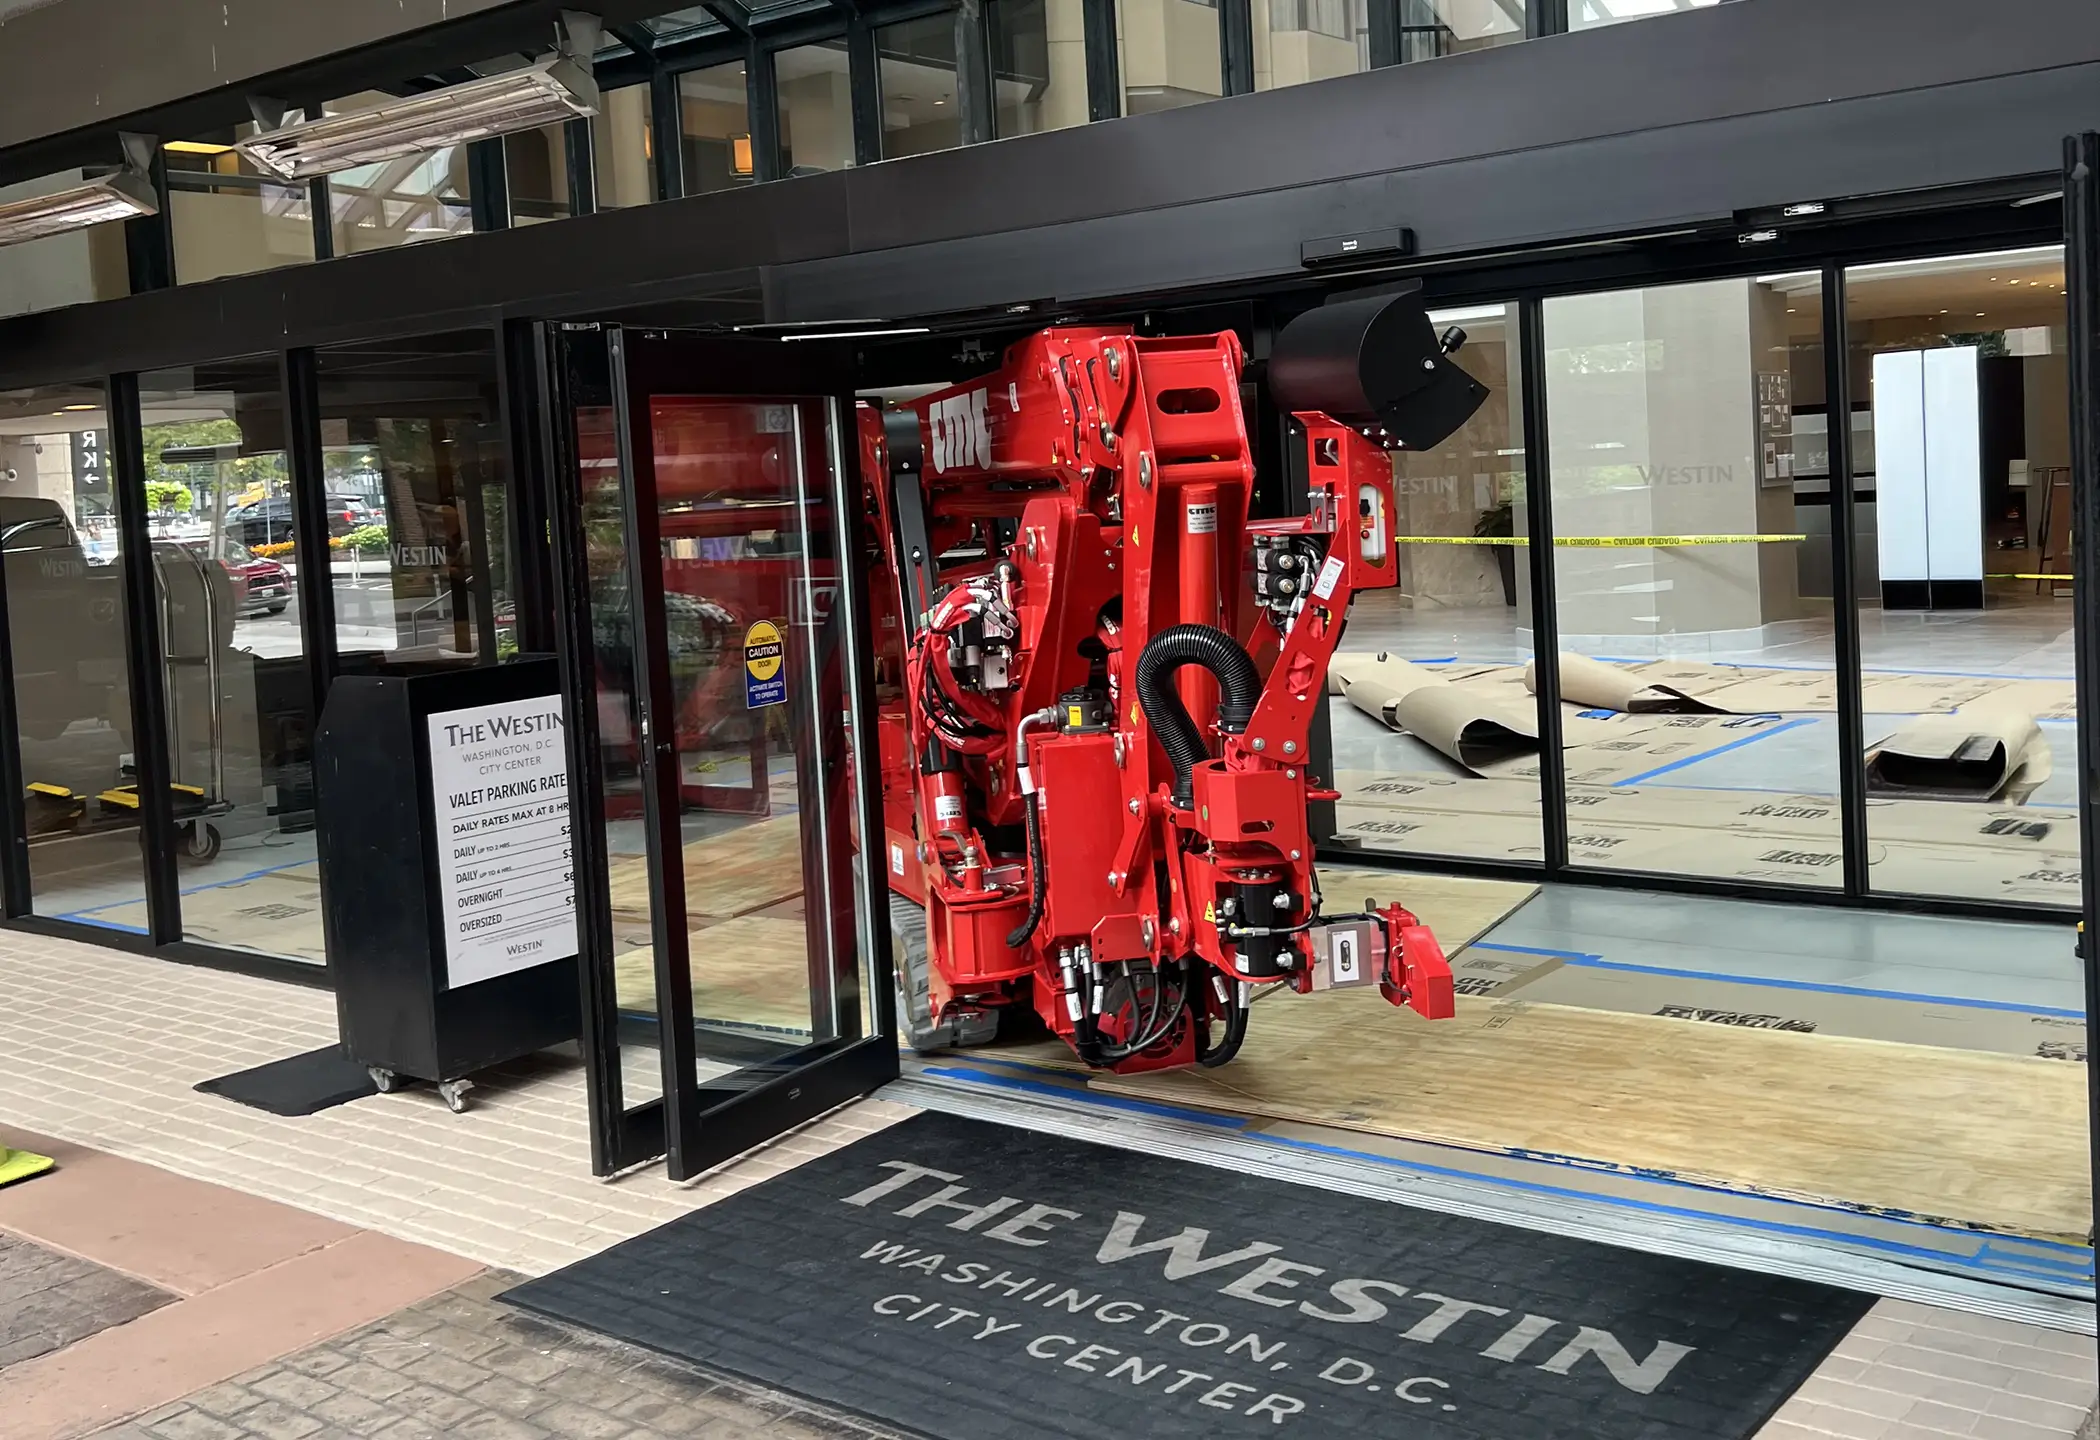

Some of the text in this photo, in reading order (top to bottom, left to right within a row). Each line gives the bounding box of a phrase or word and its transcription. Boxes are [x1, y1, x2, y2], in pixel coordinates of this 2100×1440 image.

[1637, 464, 1732, 486] WESTIN
[385, 542, 447, 567] WESTIN
[38, 557, 83, 579] WESTIN
[750, 635, 776, 645] AUTOMATIC
[748, 644, 779, 658] CAUTION
[758, 660, 772, 668] DOOR
[444, 712, 564, 746] THE WESTIN
[462, 743, 533, 763] WASHINGTON,
[479, 756, 542, 775] CITY CENTER
[449, 789, 484, 809] VALET
[487, 779, 537, 802] PARKING
[453, 820, 479, 834] DAILY
[482, 814, 510, 828] RATES
[512, 809, 534, 822] MAX
[535, 805, 547, 817] AT
[549, 804, 554, 814] 8
[454, 845, 476, 859] DAILY
[456, 869, 478, 884] DAILY
[458, 888, 503, 908] OVERNIGHT
[459, 913, 503, 933] OVERSIZED
[506, 939, 543, 956] WESTIN
[839, 1160, 1698, 1394] THE WESTIN
[859, 1239, 1458, 1412] WASHINGTON, D.C.
[872, 1294, 1306, 1425] CITY CENTER
